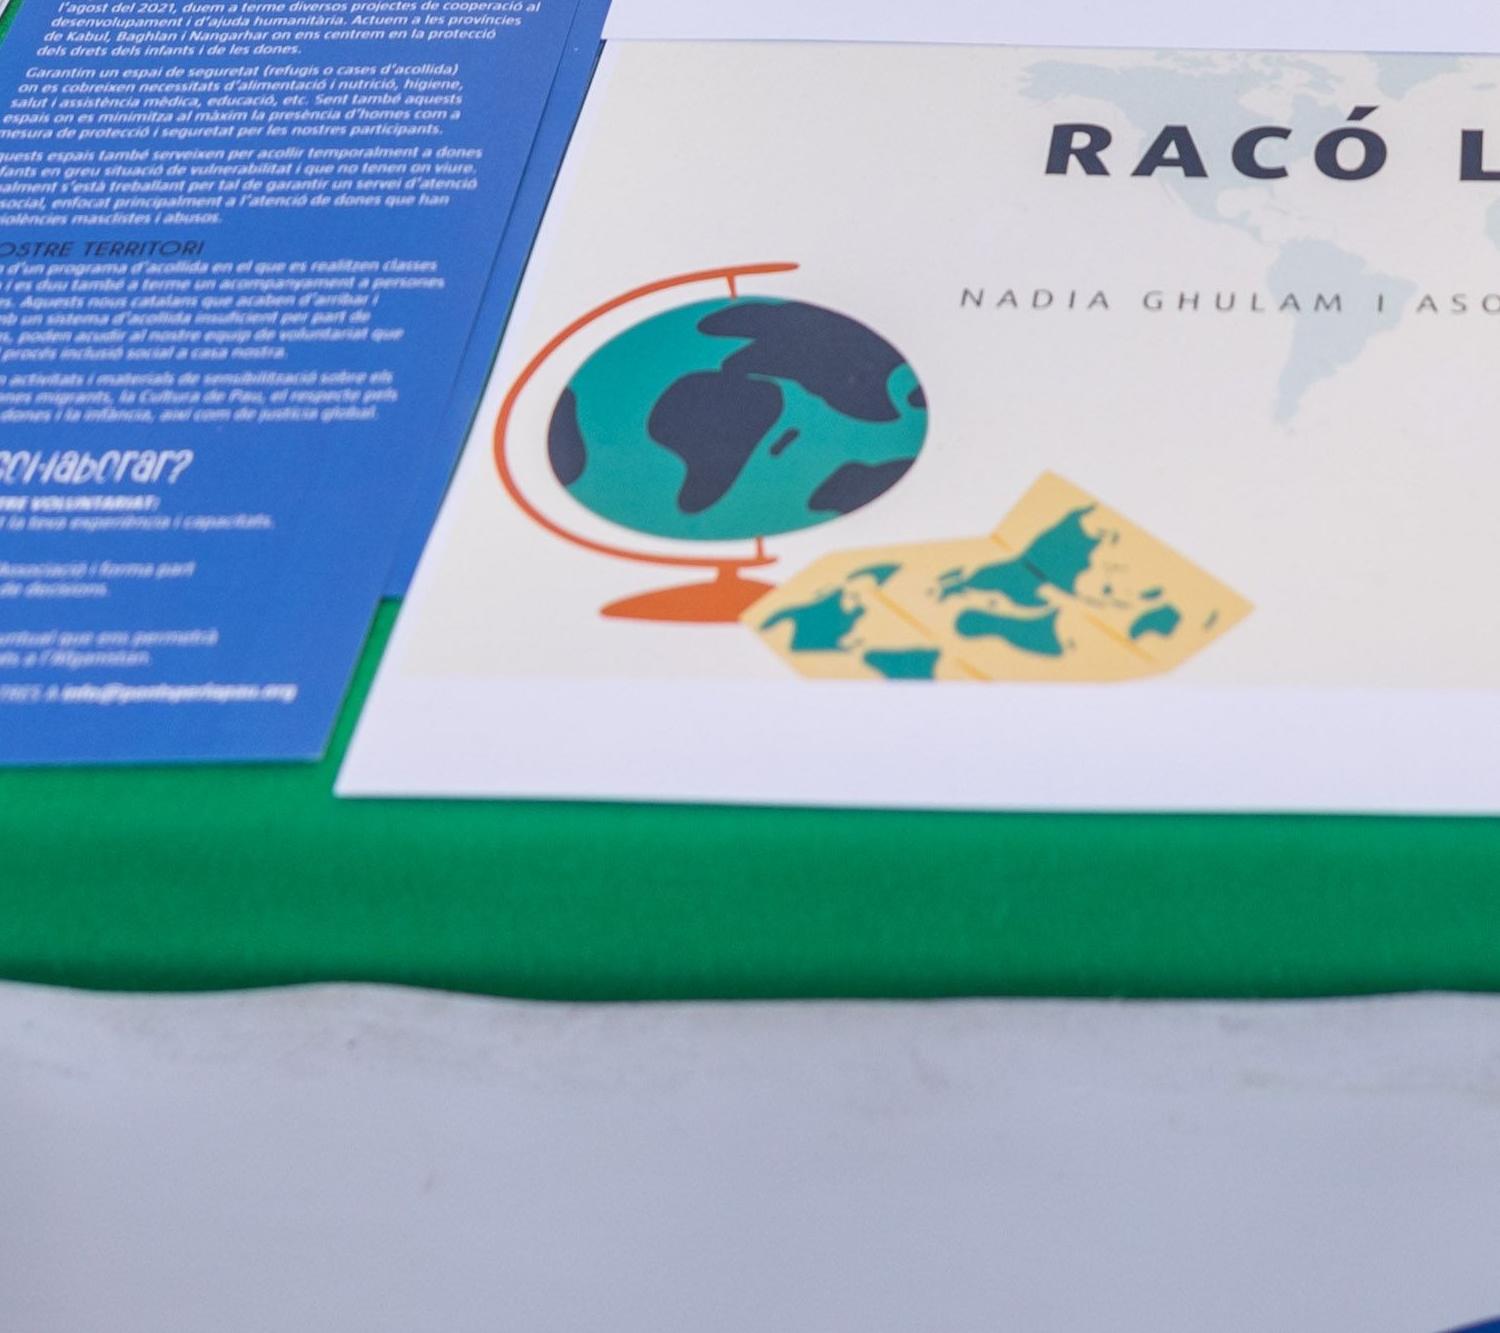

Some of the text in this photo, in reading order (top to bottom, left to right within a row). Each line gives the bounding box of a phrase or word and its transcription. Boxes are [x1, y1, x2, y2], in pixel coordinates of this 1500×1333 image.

[1045, 106, 1387, 181] RACÓ
[84, 240, 204, 256] TERRITORI
[960, 287, 1109, 309] NADIA
[1142, 291, 1342, 312] GHULAM
